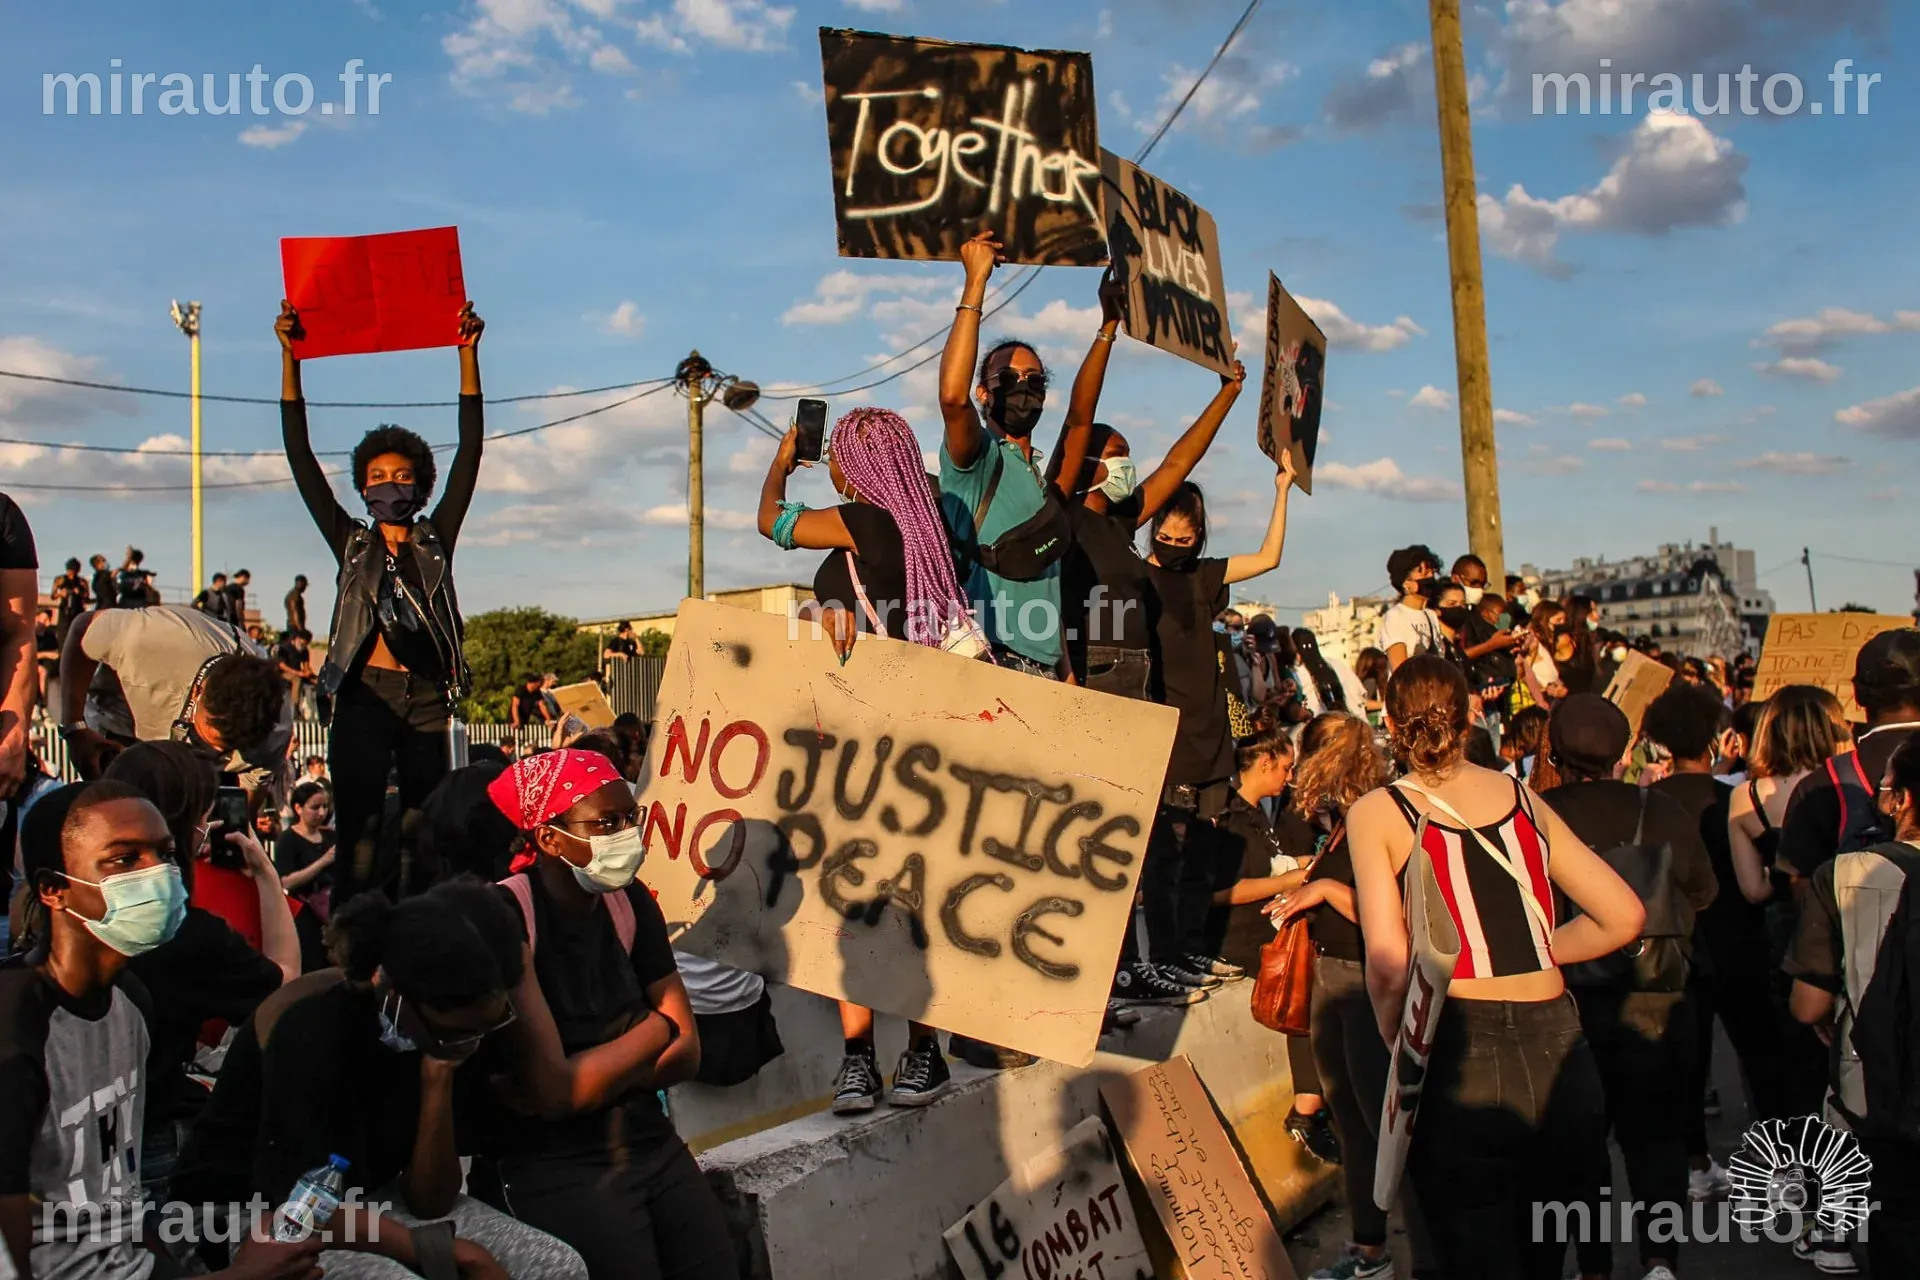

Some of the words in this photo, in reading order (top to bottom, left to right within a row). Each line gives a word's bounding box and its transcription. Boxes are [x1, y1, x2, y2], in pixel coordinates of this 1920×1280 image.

[1133, 169, 1204, 253] BLACK
[1143, 227, 1212, 300] LIVES
[1777, 618, 1818, 644] PAS
[660, 714, 771, 799] NO
[775, 727, 1141, 892] JUSTICE
[641, 800, 746, 882] NO
[765, 810, 1085, 981] PEACE
[1188, 1127, 1208, 1163] en
[1151, 1153, 1206, 1268] hommes
